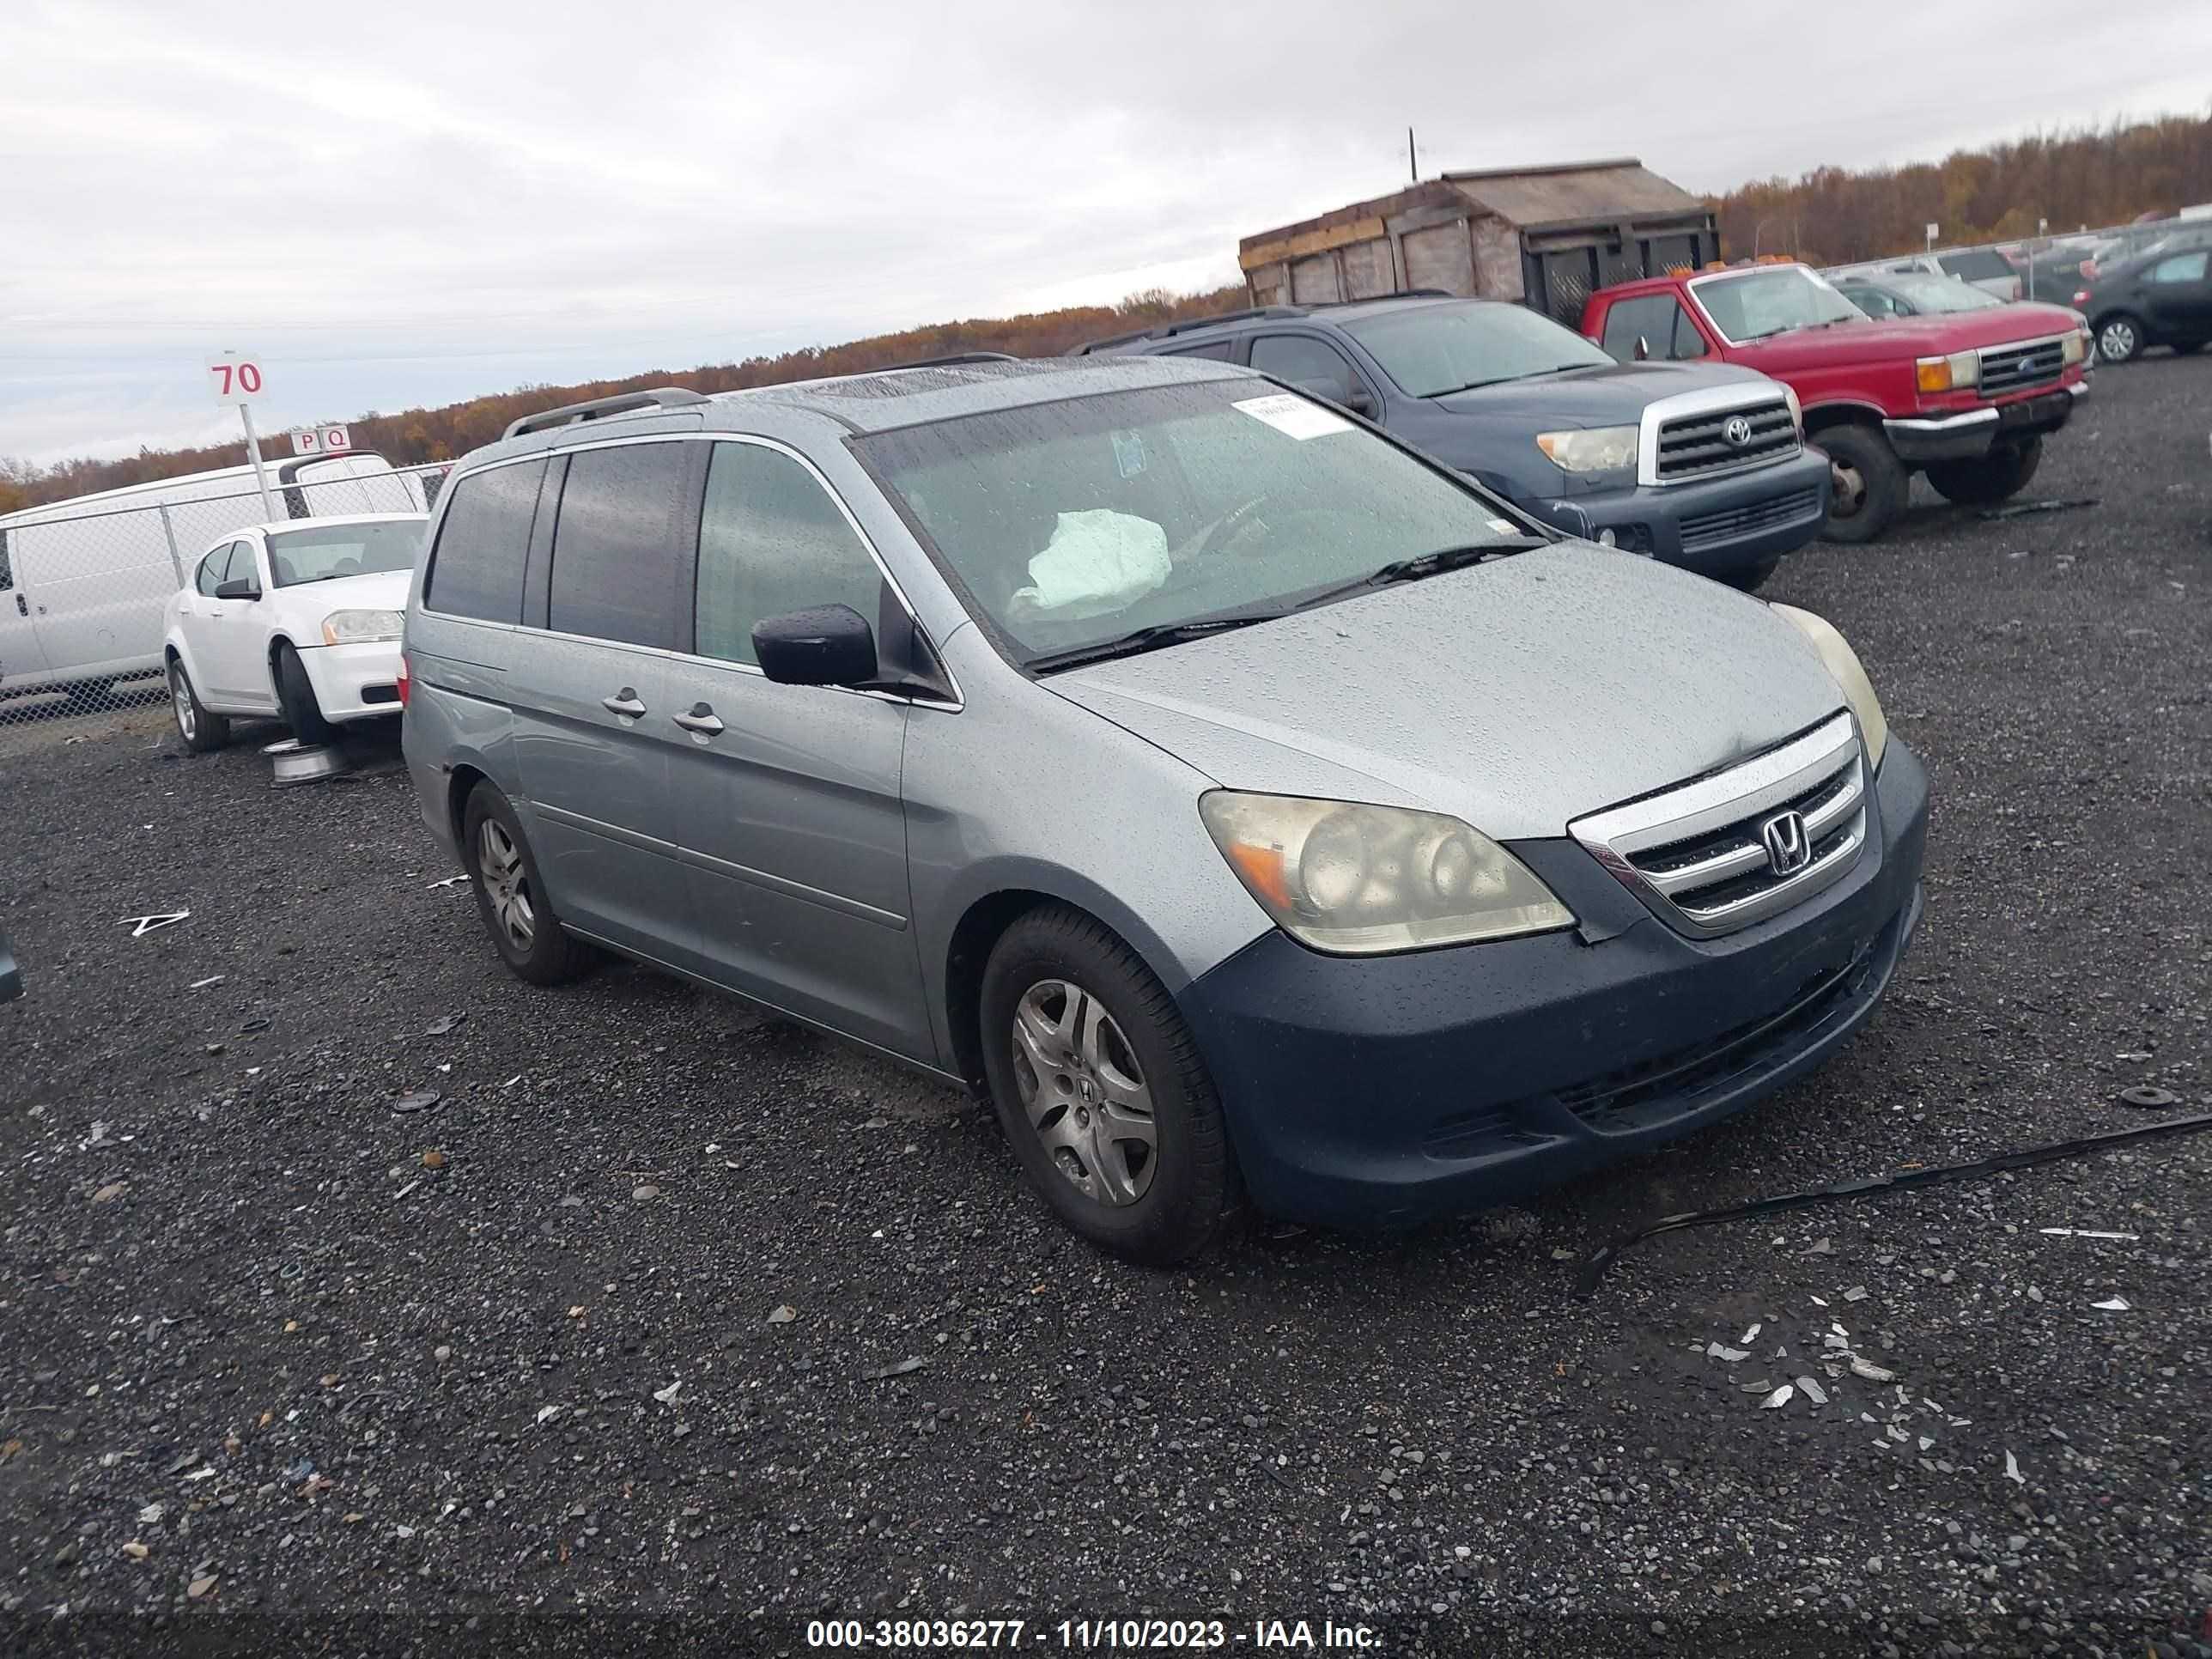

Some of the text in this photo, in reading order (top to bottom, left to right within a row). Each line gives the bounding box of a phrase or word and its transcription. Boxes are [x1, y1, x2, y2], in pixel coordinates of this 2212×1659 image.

[211, 362, 262, 395] 70
[301, 434, 313, 449] P
[328, 430, 346, 447] Q
